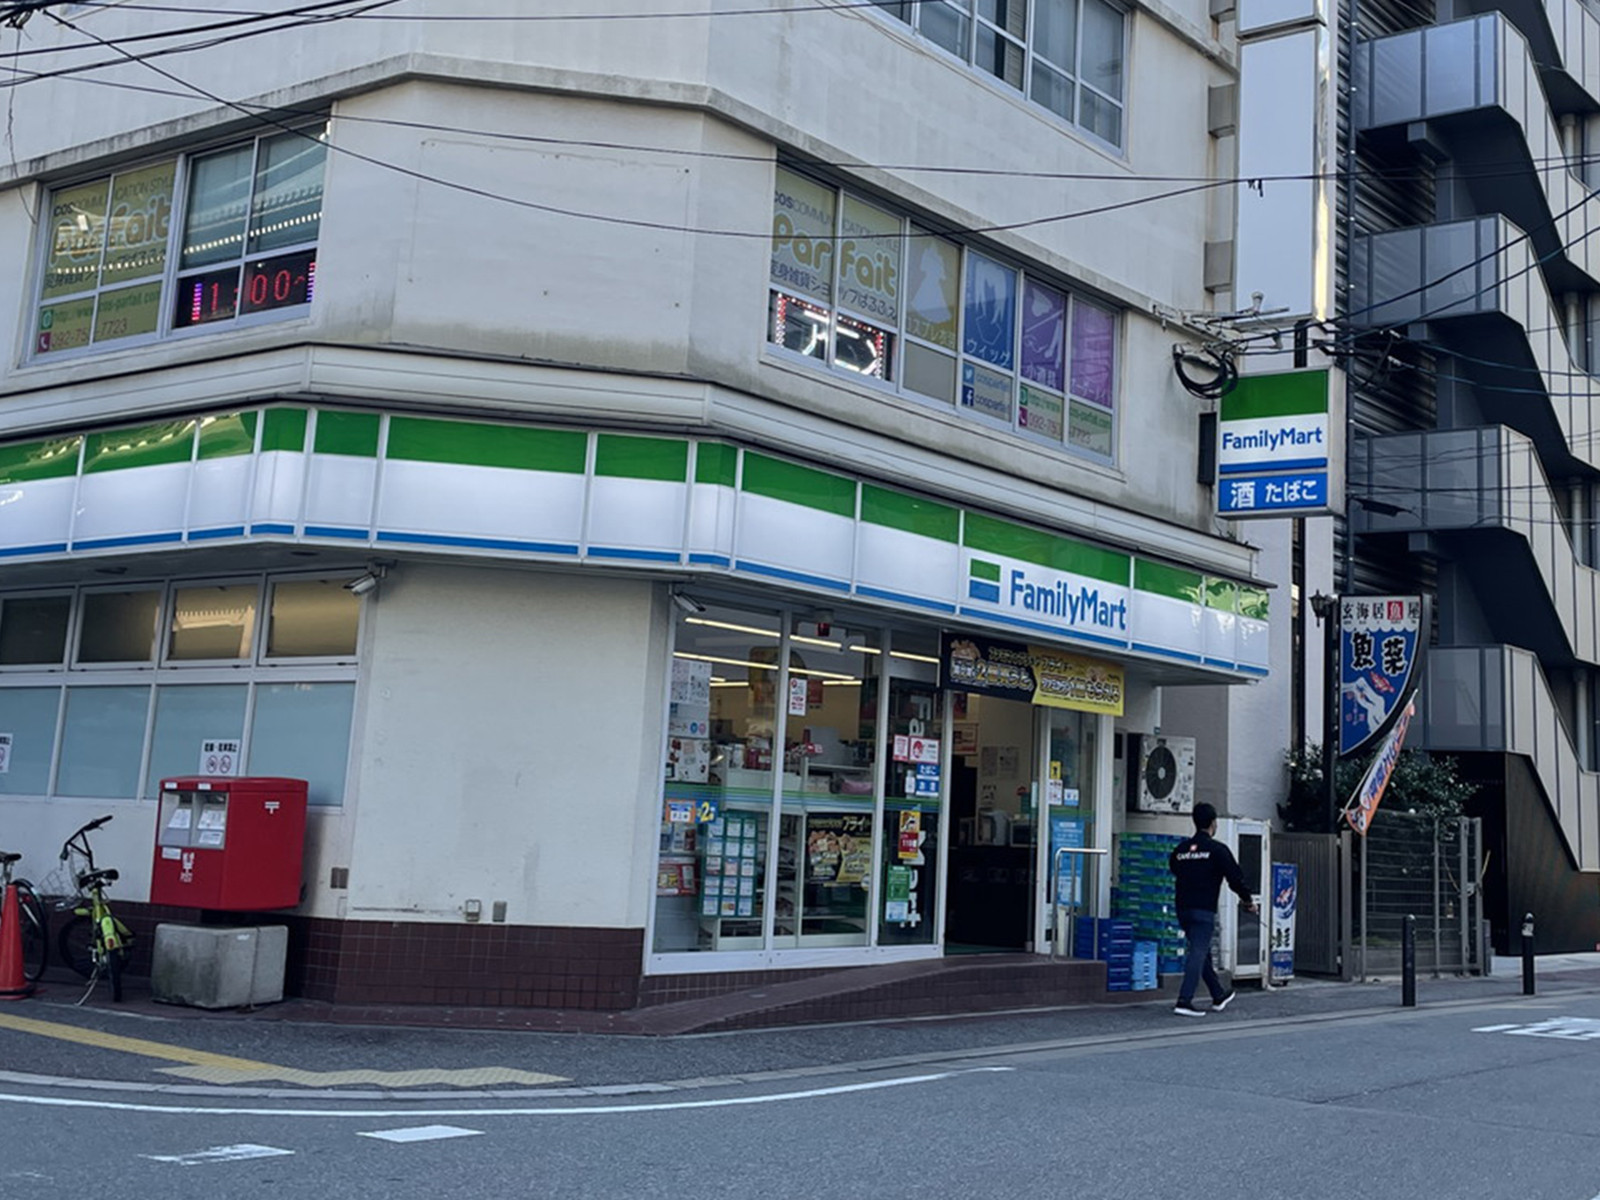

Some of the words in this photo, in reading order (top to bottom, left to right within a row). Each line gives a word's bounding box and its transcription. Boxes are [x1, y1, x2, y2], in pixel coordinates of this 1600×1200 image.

[49, 194, 172, 267] Pfait
[772, 213, 896, 298] Parfait
[1222, 427, 1323, 452] FamilyMart
[1230, 481, 1256, 508] 酒
[1265, 480, 1318, 503] たばこ
[1010, 569, 1127, 631] FamilyMart
